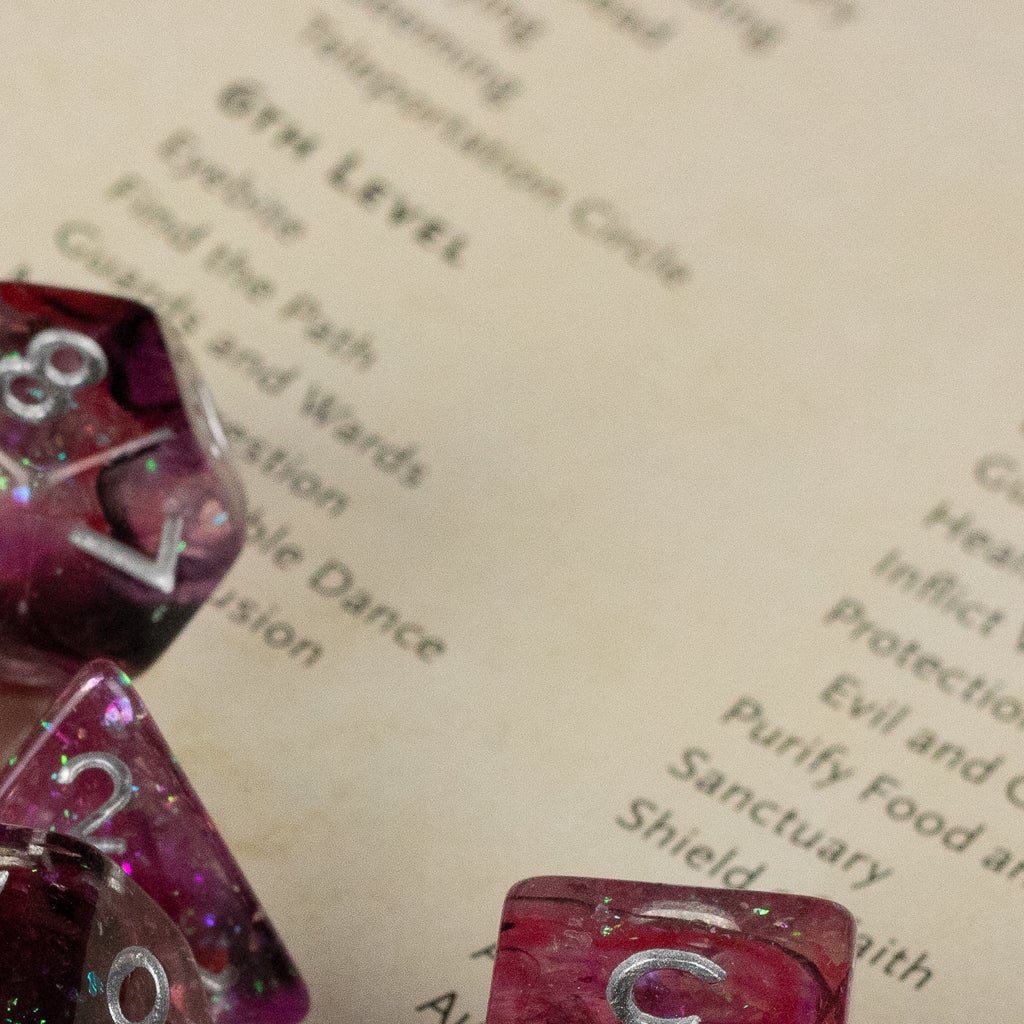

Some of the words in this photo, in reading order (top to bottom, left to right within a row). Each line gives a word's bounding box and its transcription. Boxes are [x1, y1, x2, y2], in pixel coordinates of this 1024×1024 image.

[106, 174, 209, 253] Find
[203, 243, 276, 298] the
[280, 295, 376, 371] Path
[568, 196, 690, 286] Circle
[207, 333, 298, 395] and
[300, 385, 428, 490] Wards
[308, 556, 447, 665] Dance
[873, 547, 1005, 638] Inflict
[824, 596, 1024, 732] Protectio
[719, 695, 855, 790] Purify
[859, 772, 986, 853] Food
[819, 673, 913, 736] Evil
[906, 726, 1005, 787] and
[53, 751, 133, 853] 2
[615, 797, 767, 890] Shield
[667, 746, 894, 891] Sanctuary
[854, 930, 934, 991] aith
